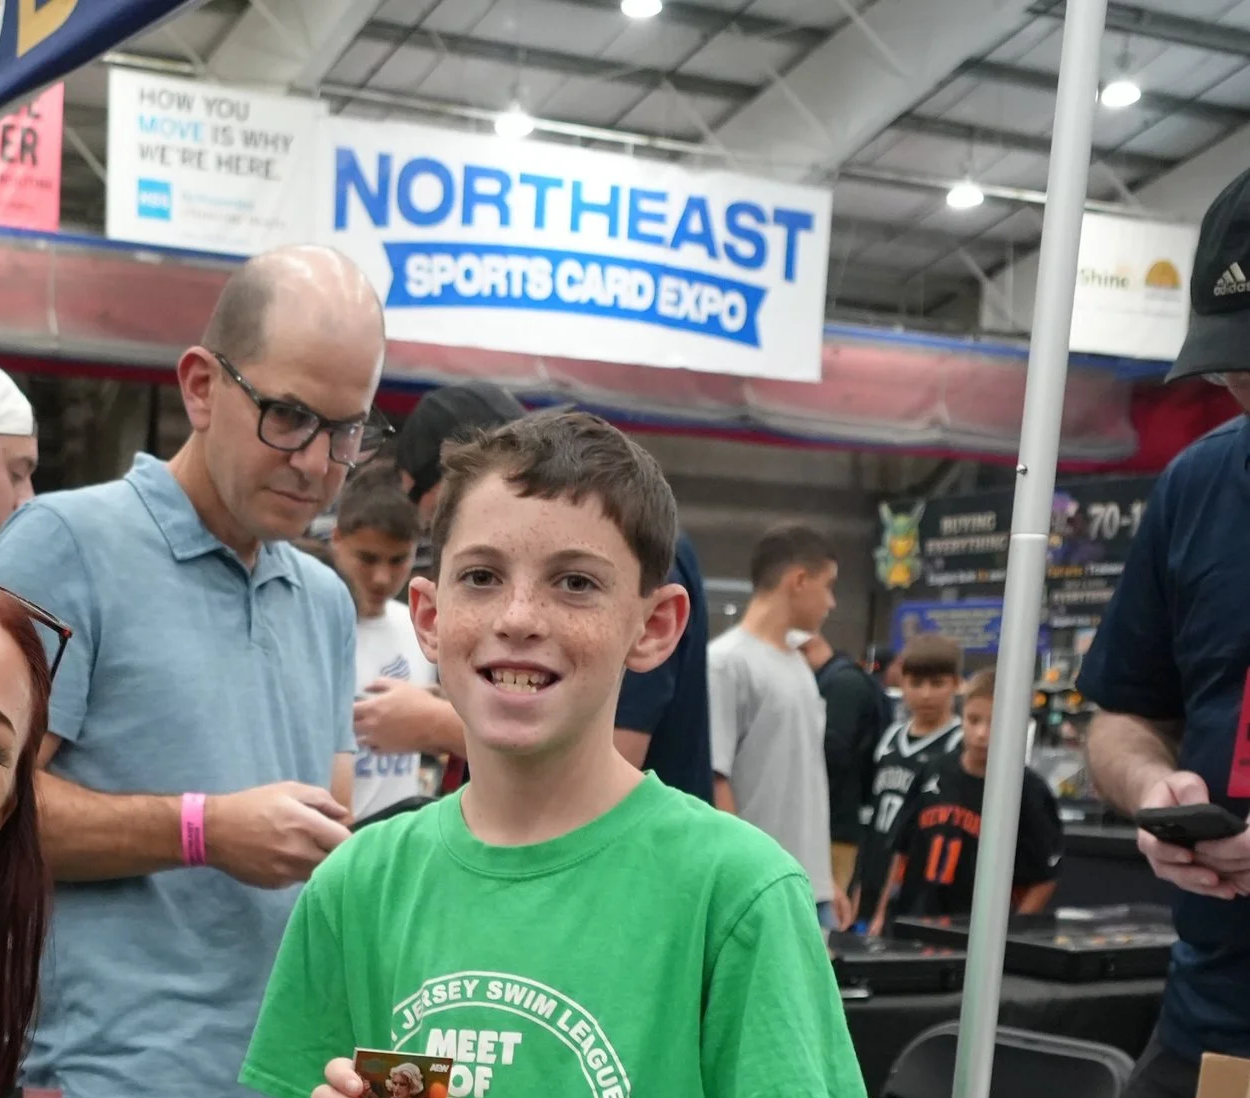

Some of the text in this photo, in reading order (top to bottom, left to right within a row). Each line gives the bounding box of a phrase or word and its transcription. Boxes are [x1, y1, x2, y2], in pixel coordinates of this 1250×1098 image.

[138, 87, 250, 122] HOW YOU
[138, 115, 295, 155] MOVE IS WHY
[138, 143, 209, 172] WE'RE
[334, 146, 814, 284] NORTHEAST
[405, 252, 748, 334] SPORTS CARD EXPO
[925, 834, 962, 885] 11
[402, 979, 480, 1030] JERSEY
[485, 980, 558, 1020] SWIM
[426, 1028, 523, 1066] MEET
